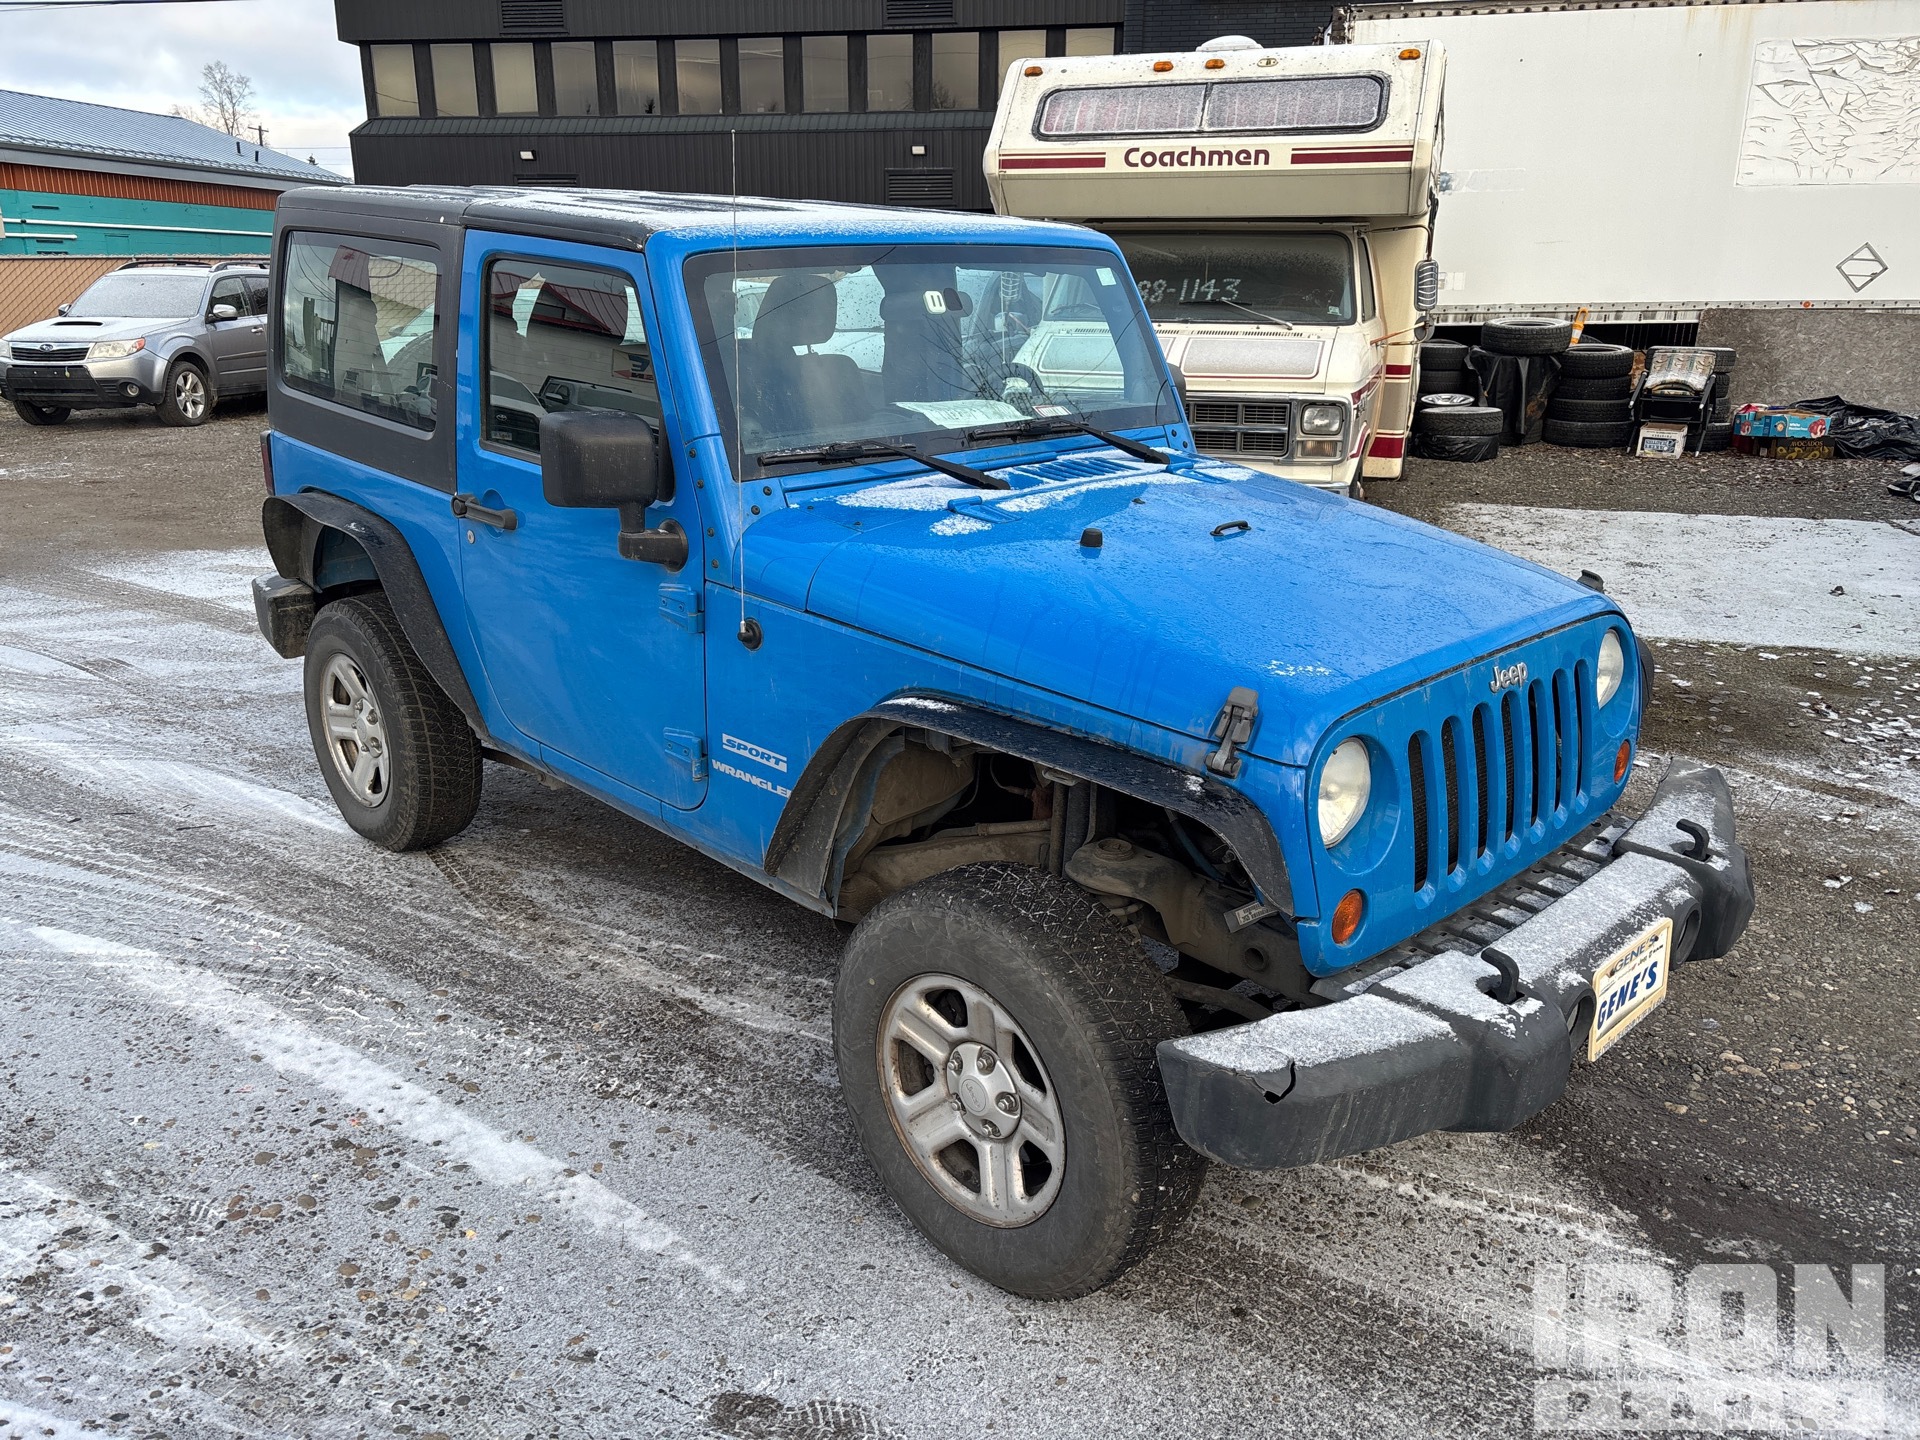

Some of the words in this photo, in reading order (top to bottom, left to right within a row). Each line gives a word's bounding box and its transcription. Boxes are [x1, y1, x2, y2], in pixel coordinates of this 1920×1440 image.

[1124, 146, 1270, 168] Coachmen
[1490, 661, 1528, 693] Jeep
[723, 736, 787, 768] SPORT
[1597, 960, 1659, 1031] GENE'S
